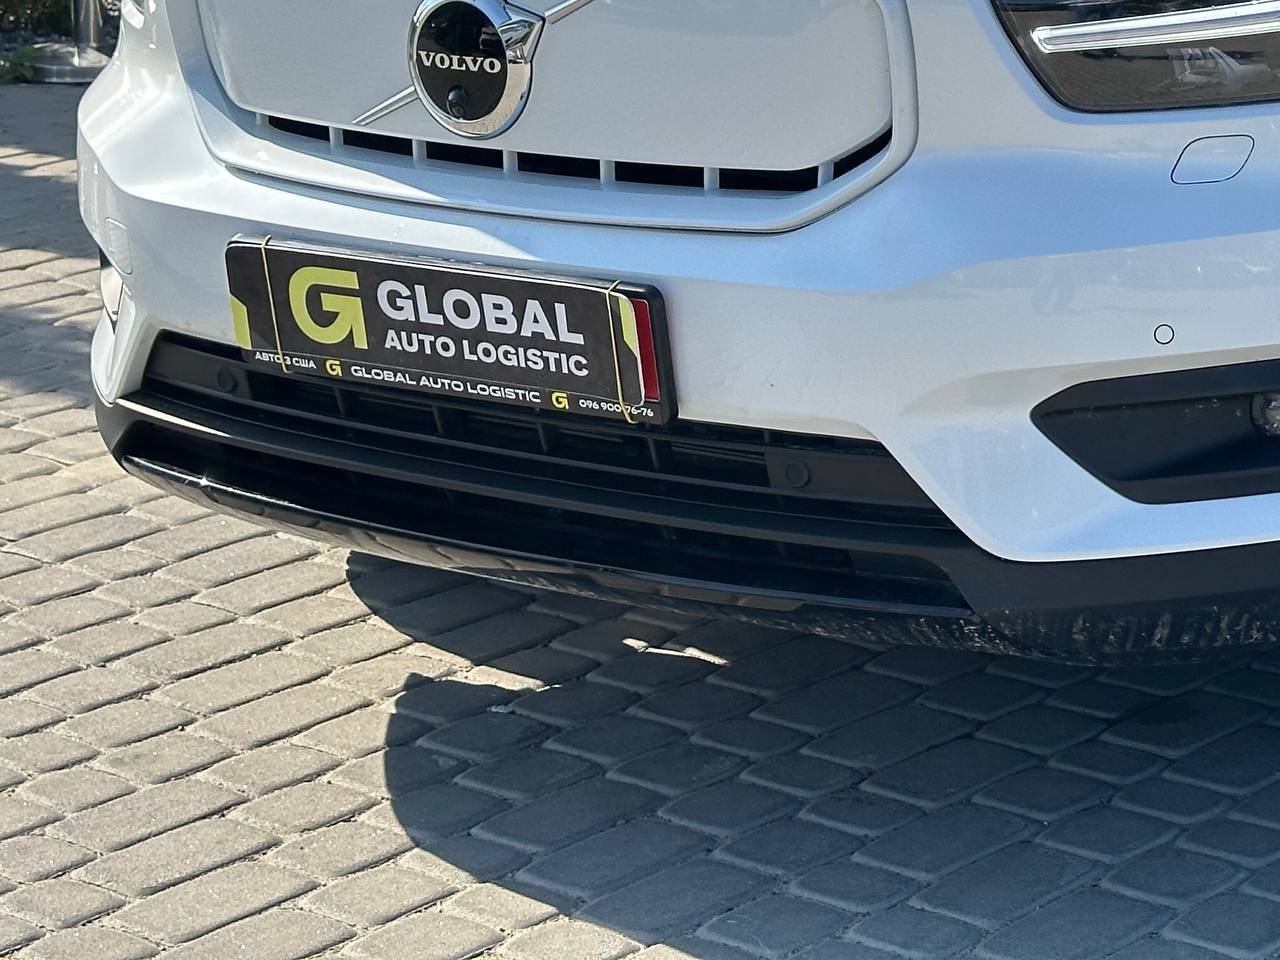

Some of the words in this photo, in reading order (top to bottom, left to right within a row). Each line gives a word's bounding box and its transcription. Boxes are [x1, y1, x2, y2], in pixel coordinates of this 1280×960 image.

[418, 51, 501, 74] VOLVO
[376, 280, 584, 345] GLOBAL
[293, 358, 317, 370] США
[384, 329, 456, 358] AUTO
[462, 341, 590, 377] LOGISTIC
[350, 365, 417, 385] GLOBAL
[419, 375, 464, 392] AUTO
[466, 382, 541, 403] LOGISTIC
[579, 399, 600, 410] 096
